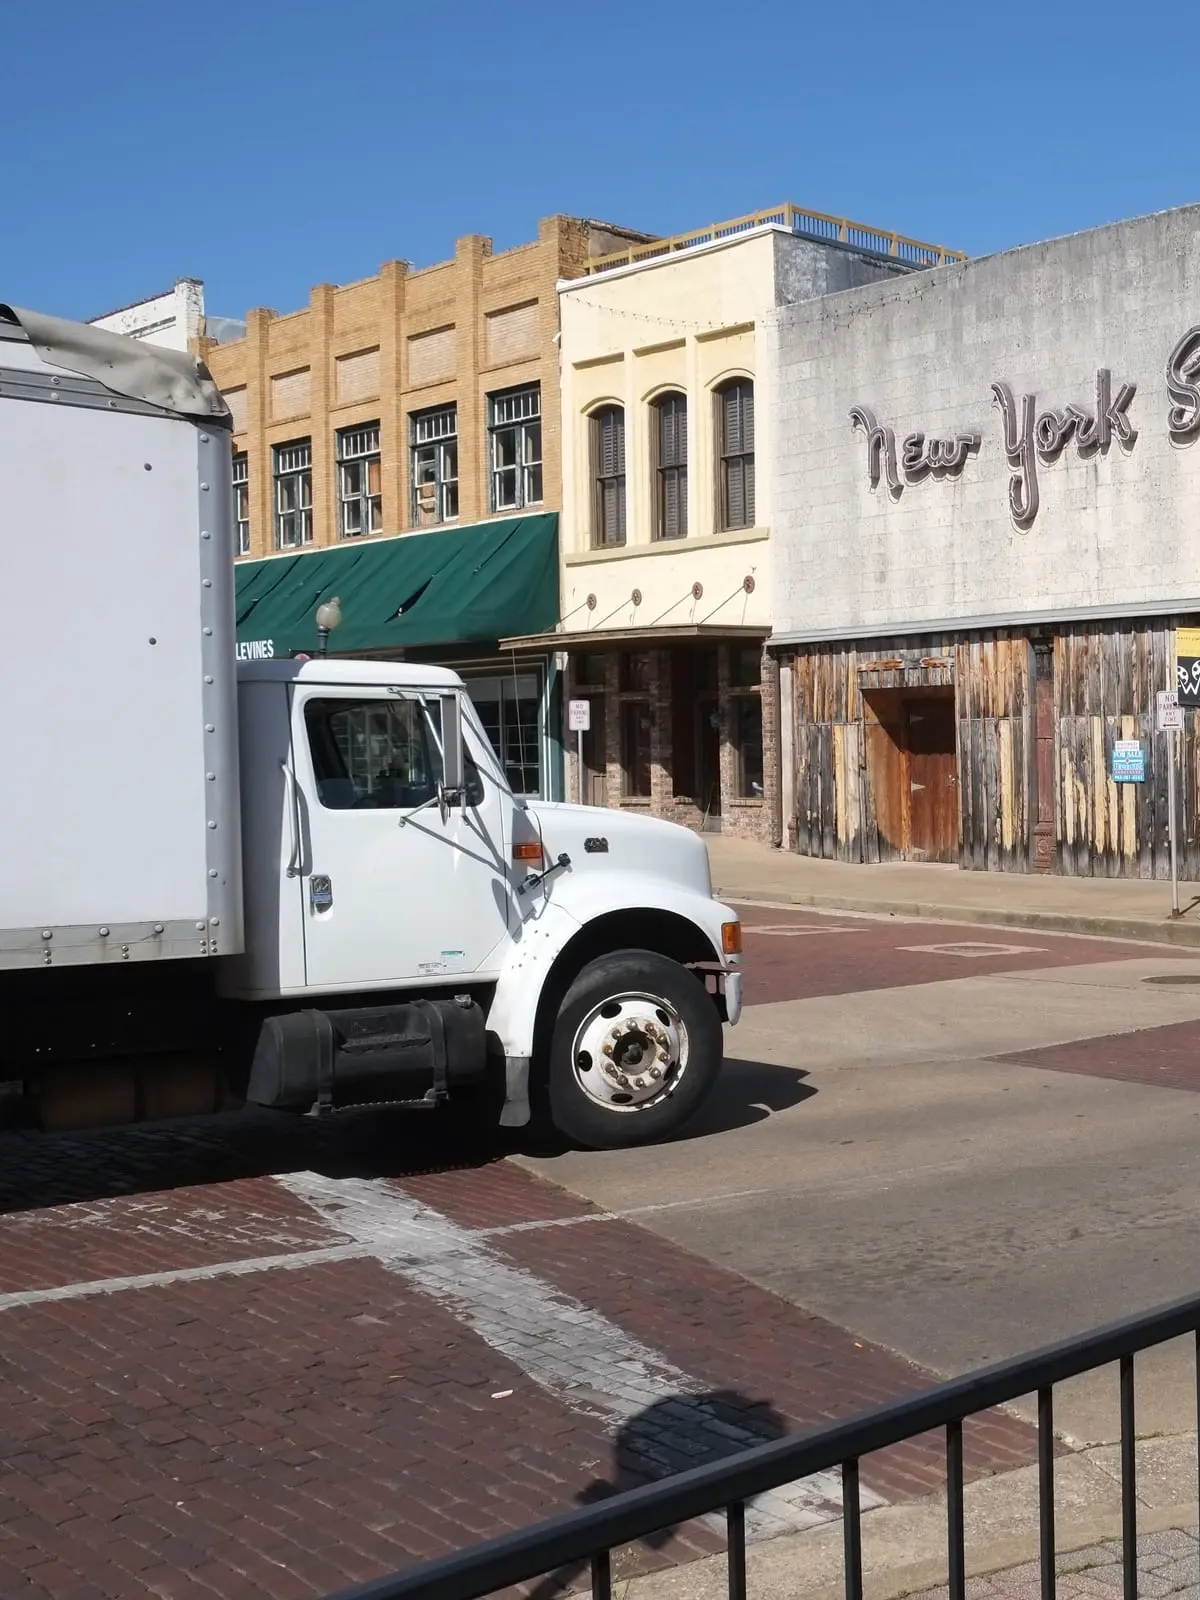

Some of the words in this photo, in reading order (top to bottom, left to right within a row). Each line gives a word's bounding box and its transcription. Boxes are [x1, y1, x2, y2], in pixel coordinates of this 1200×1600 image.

[848, 404, 981, 490] New
[991, 367, 1137, 522] York
[235, 639, 274, 661] LEVINES
[1165, 694, 1175, 702] NO
